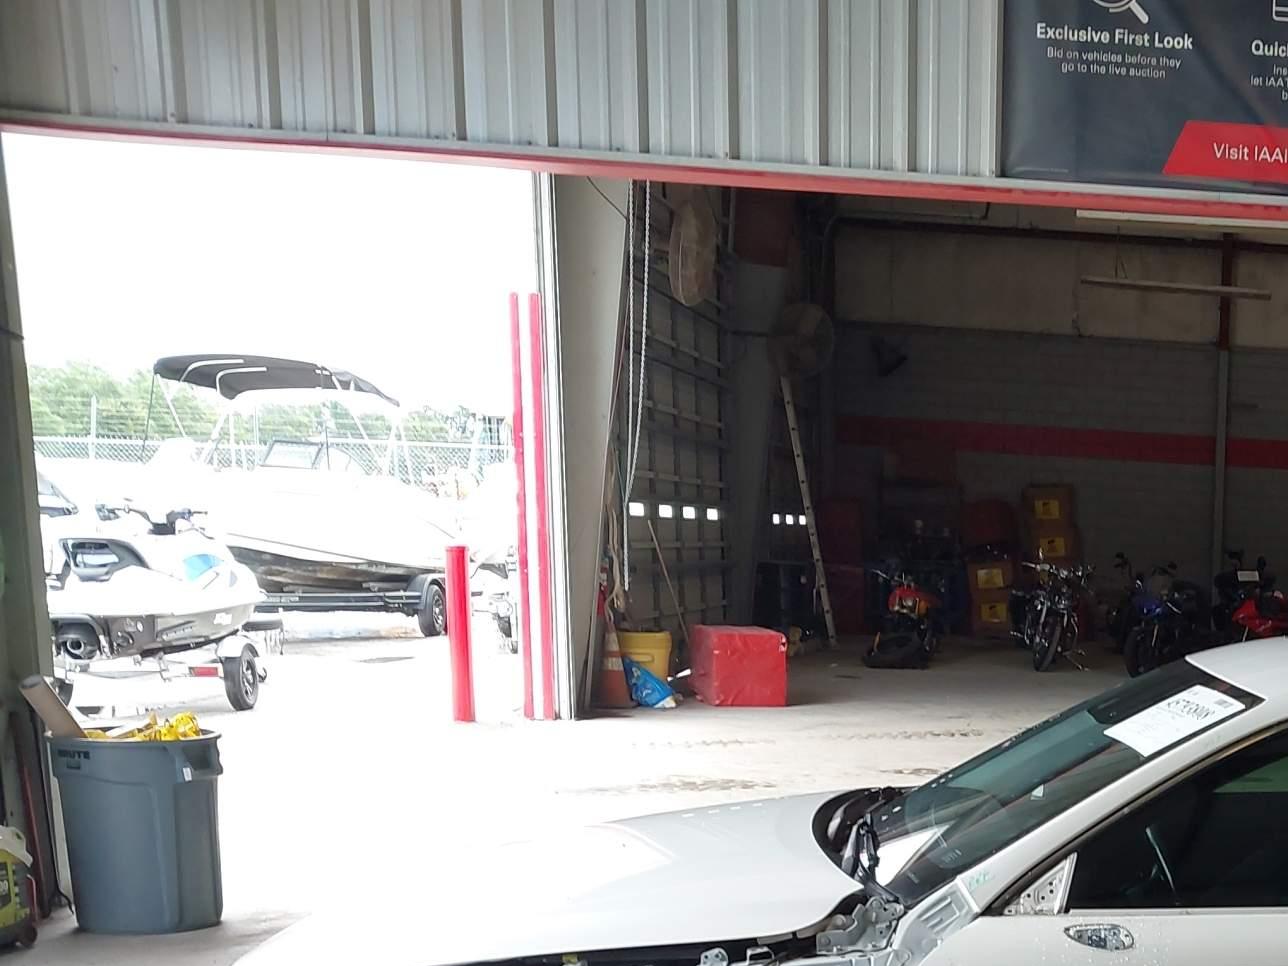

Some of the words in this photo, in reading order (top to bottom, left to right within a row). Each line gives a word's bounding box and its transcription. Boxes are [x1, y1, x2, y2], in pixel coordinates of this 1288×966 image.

[1036, 23, 1110, 43] Exclusive
[1115, 29, 1150, 47] First
[1154, 31, 1193, 50] Look
[1047, 47, 1063, 58] Bid
[1067, 51, 1079, 60] on
[1082, 51, 1122, 63] vehicles
[1125, 54, 1157, 66] before
[1159, 56, 1181, 70] they
[1061, 62, 1074, 73] go
[1077, 62, 1087, 72] to
[1090, 63, 1106, 74] the
[1109, 64, 1127, 76] live
[1129, 67, 1166, 79] auction
[1250, 75, 1263, 87] let
[1213, 143, 1249, 161] Visit
